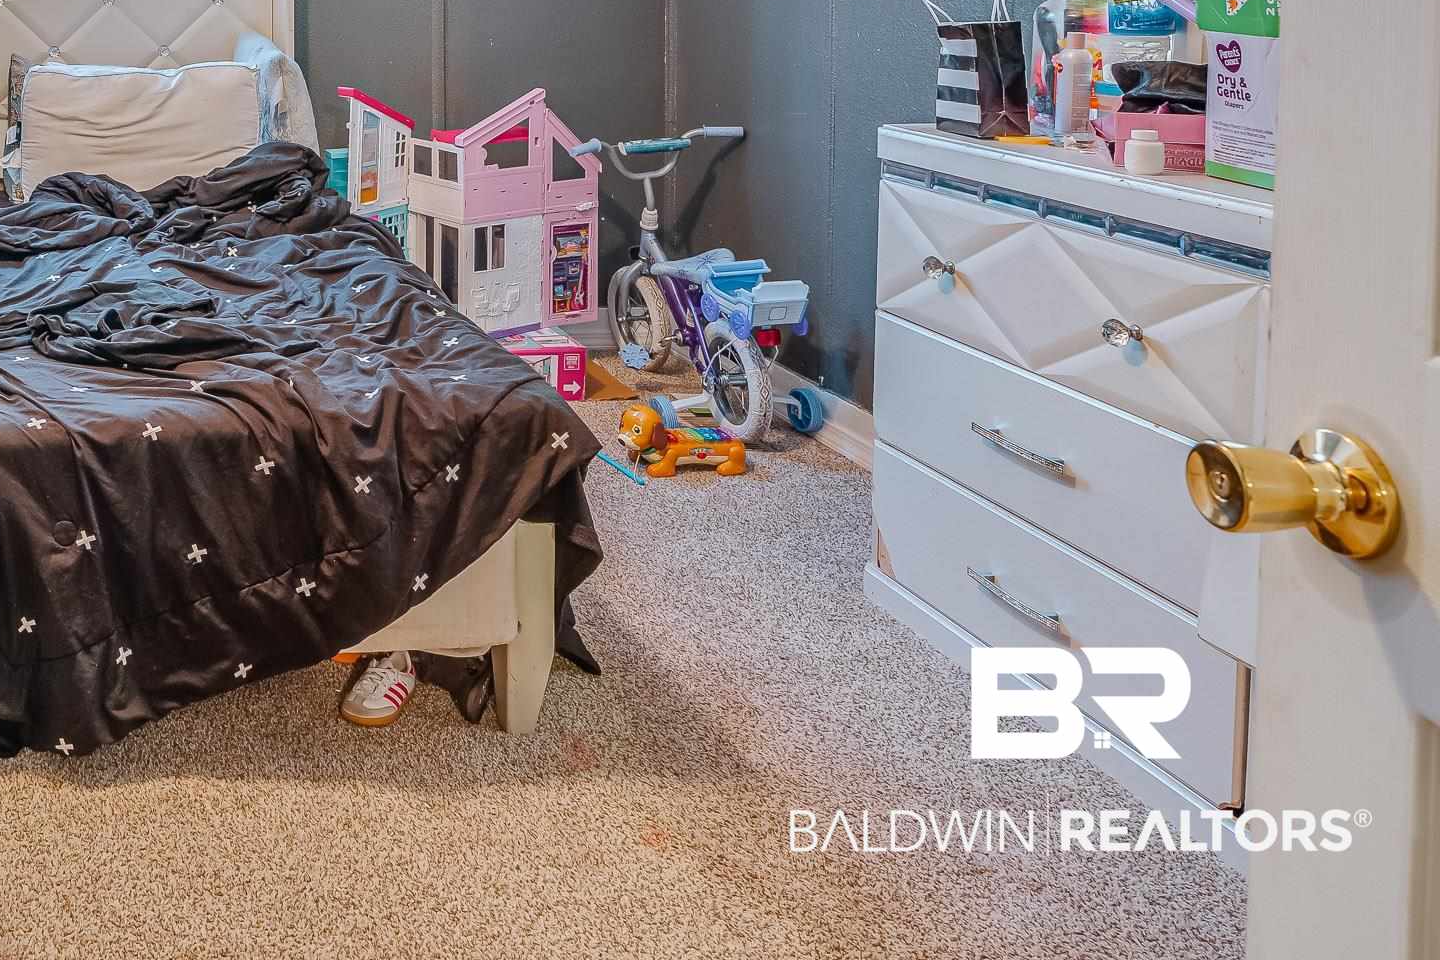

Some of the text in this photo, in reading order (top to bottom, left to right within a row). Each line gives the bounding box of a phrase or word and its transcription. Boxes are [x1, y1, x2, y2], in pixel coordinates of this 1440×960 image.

[1217, 73, 1248, 89] Dry &
[1216, 86, 1252, 102] Gentle
